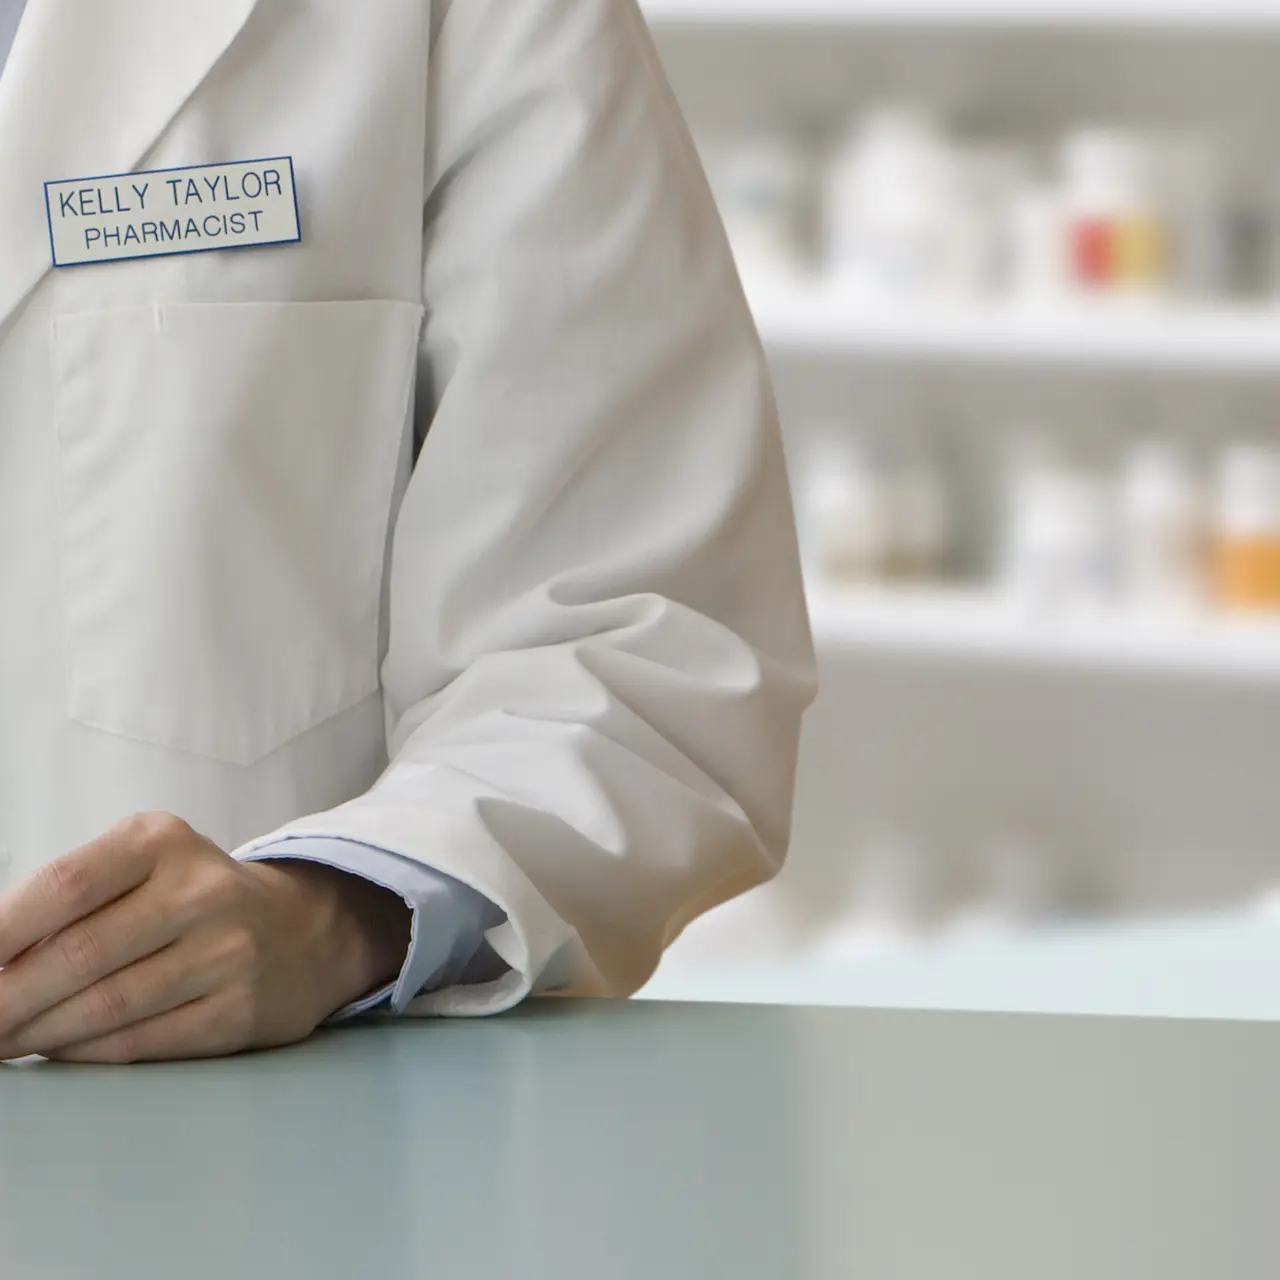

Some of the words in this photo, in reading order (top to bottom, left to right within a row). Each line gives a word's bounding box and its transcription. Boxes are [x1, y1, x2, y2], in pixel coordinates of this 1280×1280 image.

[59, 183, 149, 217] KELLY
[166, 169, 283, 206] TAYLOR
[84, 210, 264, 250] PHARMACIST
